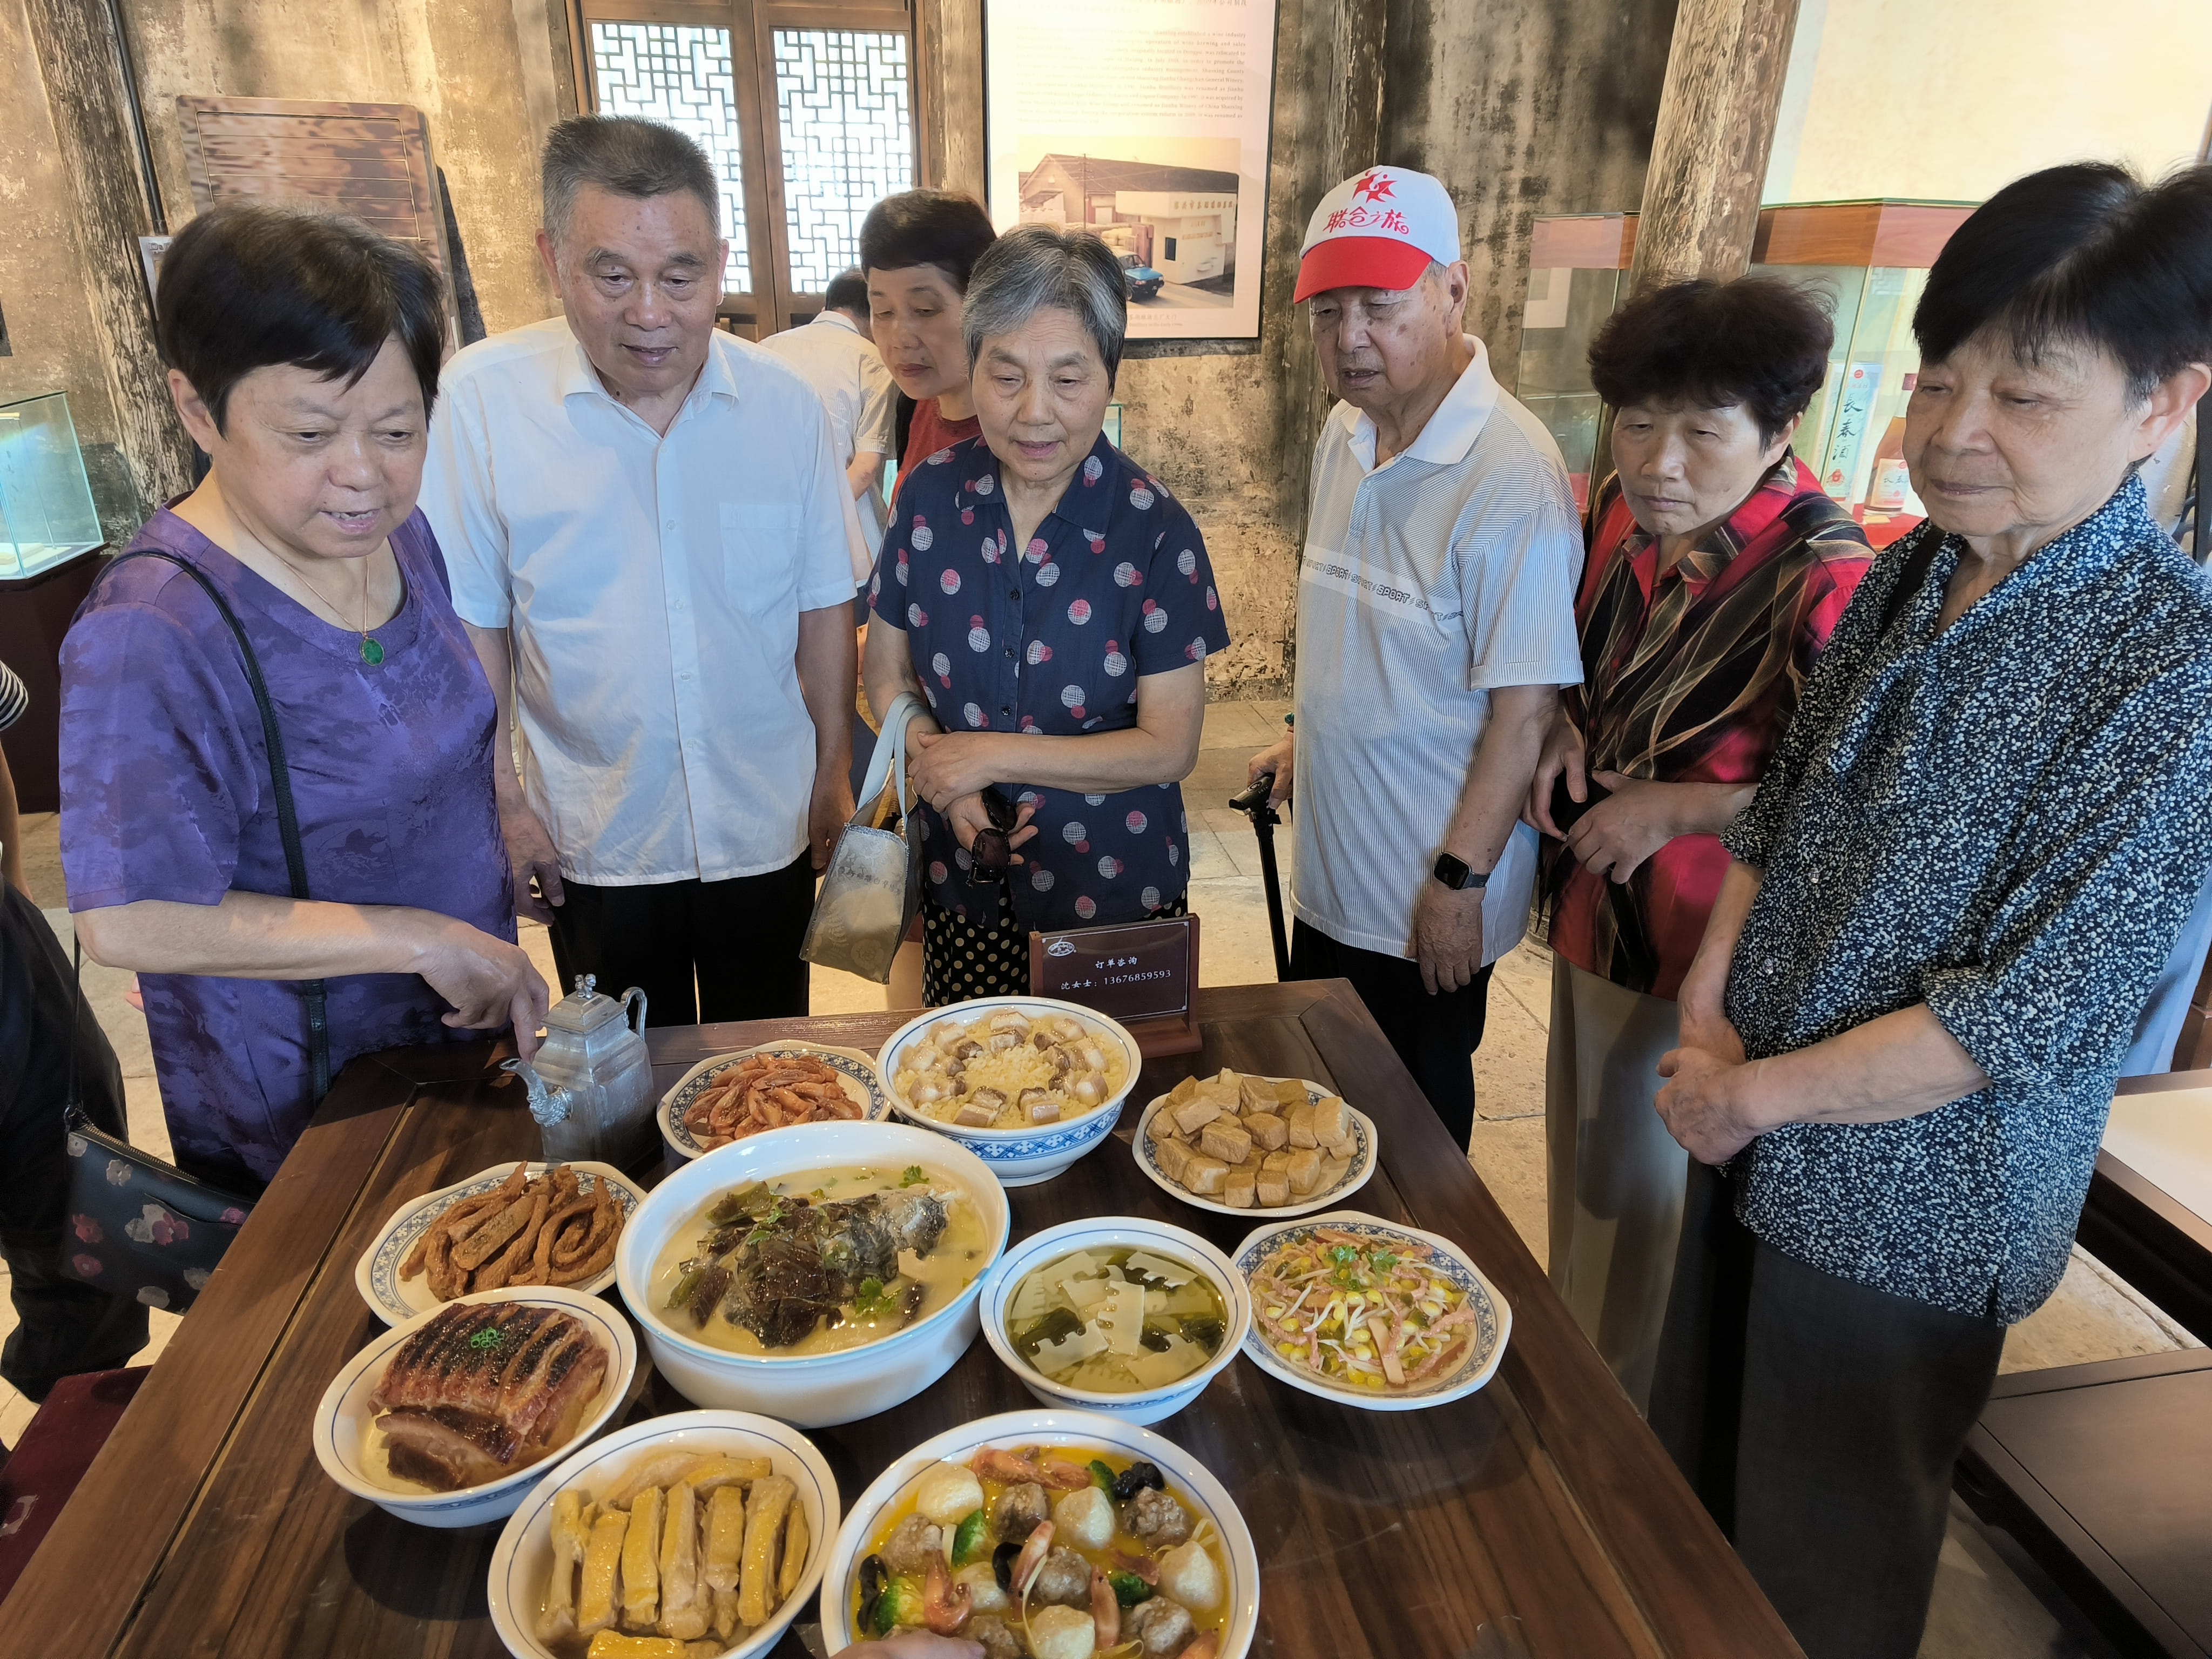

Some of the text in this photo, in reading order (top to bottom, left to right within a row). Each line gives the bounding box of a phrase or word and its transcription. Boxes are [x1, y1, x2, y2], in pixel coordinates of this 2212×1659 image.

[1326, 564, 1349, 580] SPORT
[1376, 584, 1411, 604] SPORT
[1095, 956, 1138, 969] 订单咨询
